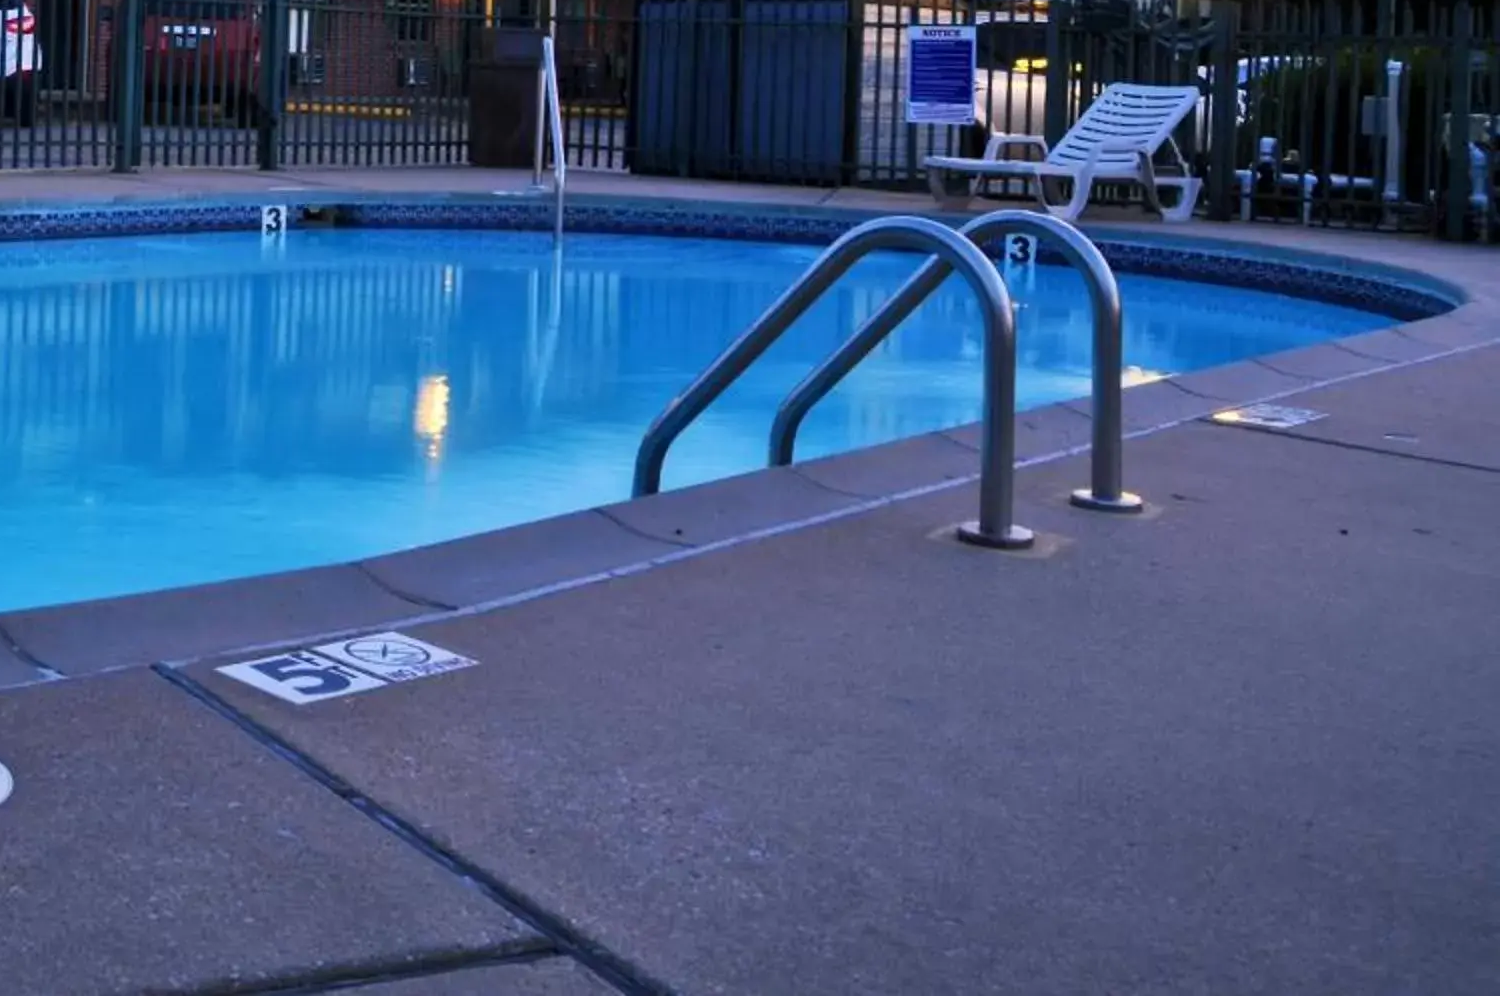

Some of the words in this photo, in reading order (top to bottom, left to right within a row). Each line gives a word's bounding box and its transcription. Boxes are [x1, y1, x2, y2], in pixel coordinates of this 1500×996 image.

[922, 29, 962, 37] NOTICE
[266, 207, 281, 233] 3
[1010, 236, 1031, 262] 3
[250, 658, 351, 695] 5
